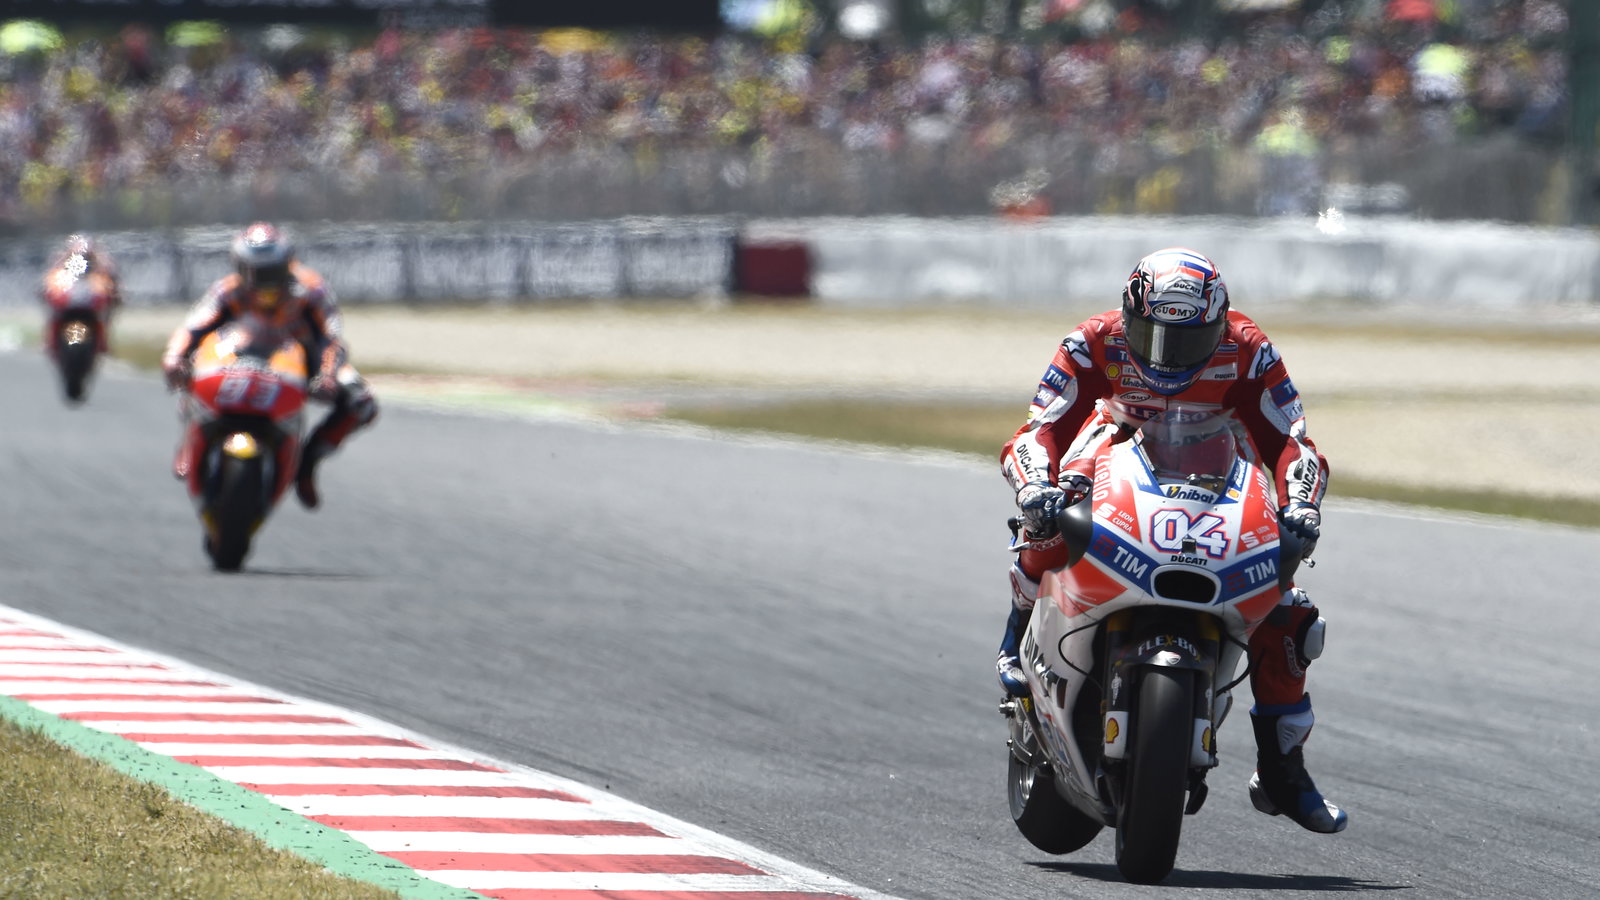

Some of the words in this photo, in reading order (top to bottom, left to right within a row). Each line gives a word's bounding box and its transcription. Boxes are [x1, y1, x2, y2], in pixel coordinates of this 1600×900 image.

[1174, 282, 1201, 294] DUCATI
[1156, 307, 1195, 317] SUOMY
[1047, 369, 1067, 390] TIM
[1298, 459, 1318, 499] DUCATI
[1166, 486, 1214, 504] Unibat
[1112, 517, 1133, 532] CUPRA
[1118, 510, 1134, 523] LEON
[1151, 508, 1230, 559] 04
[1113, 546, 1148, 580] TIM
[1170, 555, 1207, 566] DUCATI
[1244, 558, 1276, 584] TIM
